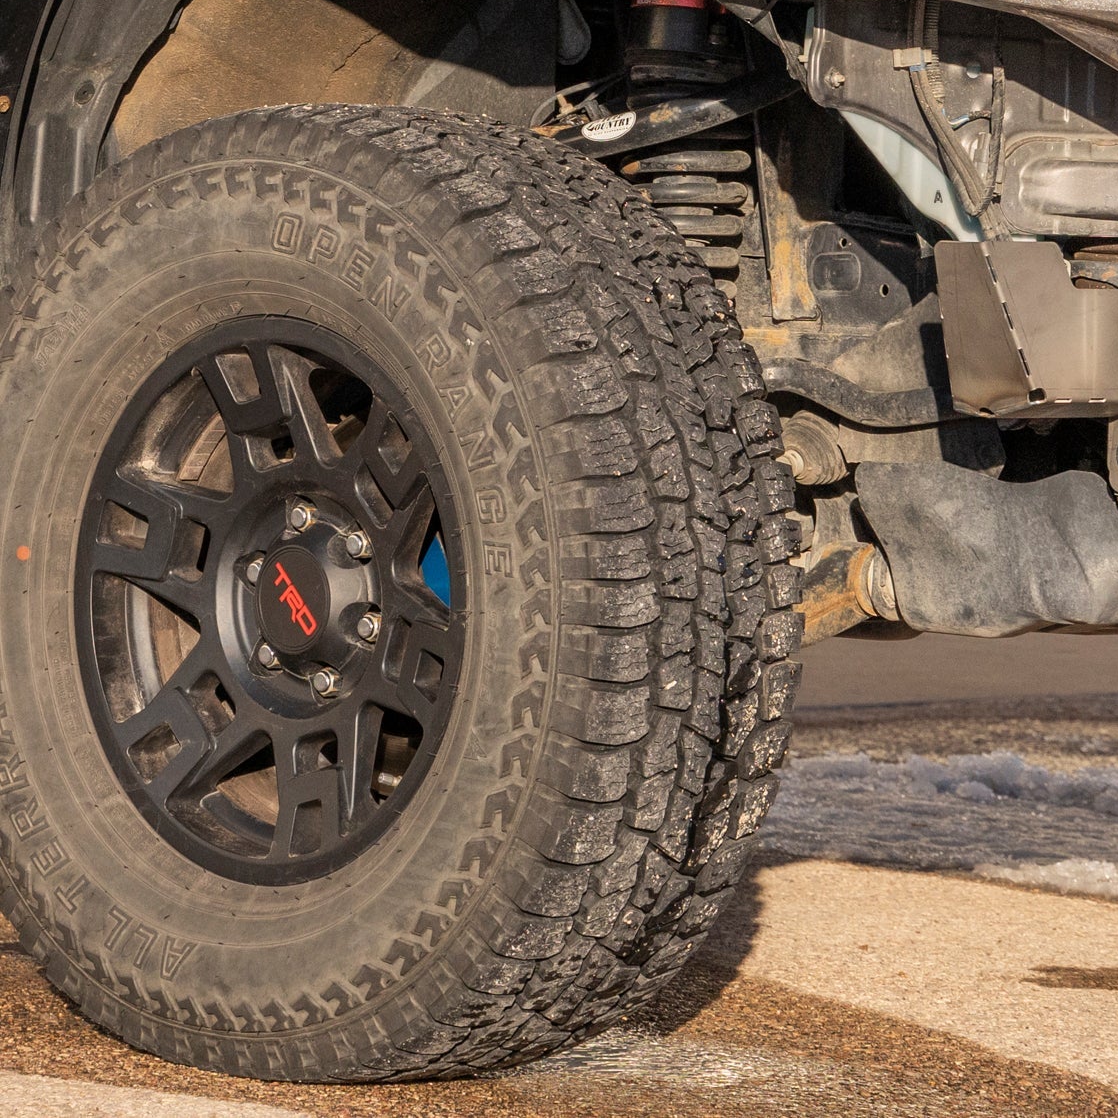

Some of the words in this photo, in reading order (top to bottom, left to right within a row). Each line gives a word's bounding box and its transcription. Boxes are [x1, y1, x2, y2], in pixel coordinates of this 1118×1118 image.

[933, 189, 943, 204] A
[272, 211, 411, 321] OPEN
[415, 331, 514, 579] RANGE
[273, 562, 317, 636] TRD
[105, 904, 197, 981] ALL
